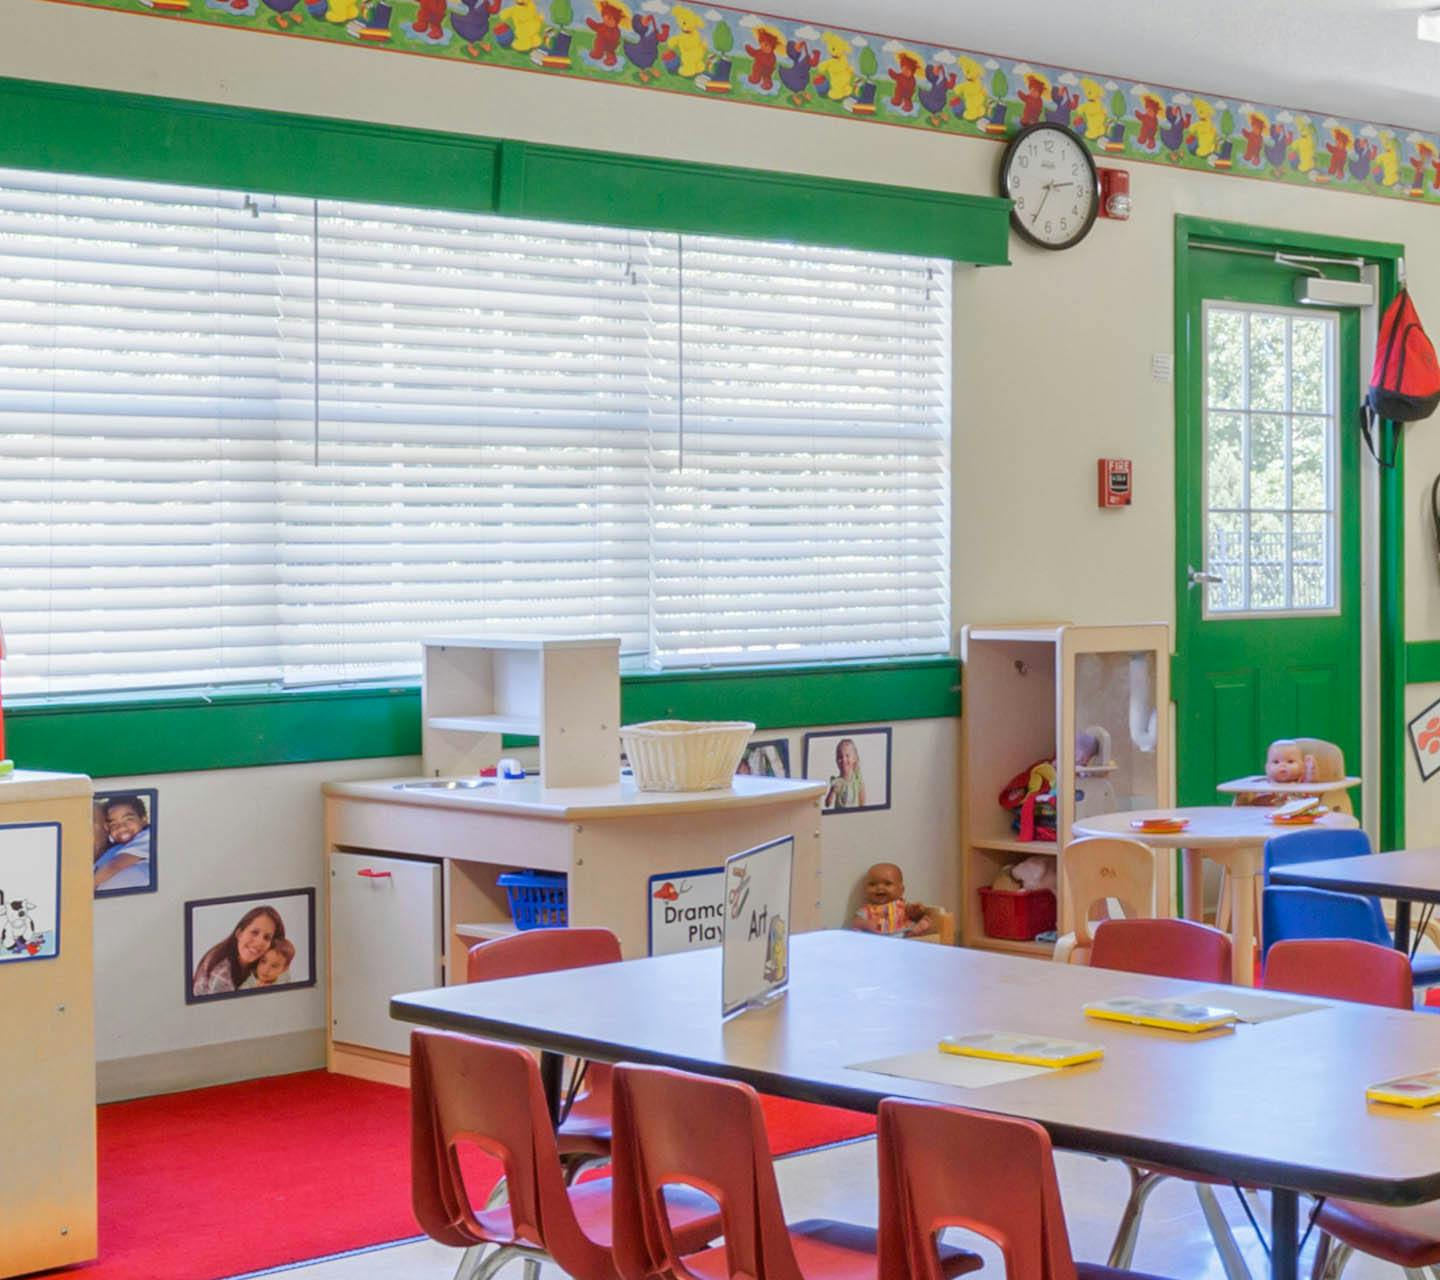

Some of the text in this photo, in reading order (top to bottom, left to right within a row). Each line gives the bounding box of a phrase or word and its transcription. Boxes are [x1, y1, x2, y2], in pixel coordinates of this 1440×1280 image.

[1028, 143, 1038, 158] 11
[1043, 140, 1055, 153] 12
[1017, 154, 1029, 169] 10
[1071, 162, 1080, 177] 2
[1011, 175, 1020, 189] 9
[1076, 185, 1085, 198] 3
[1017, 196, 1025, 210] 8
[1071, 204, 1079, 217] 4
[1044, 220, 1053, 234] 6
[1059, 217, 1068, 231] 5
[1109, 459, 1130, 472] FIRE
[747, 903, 769, 943] Art
